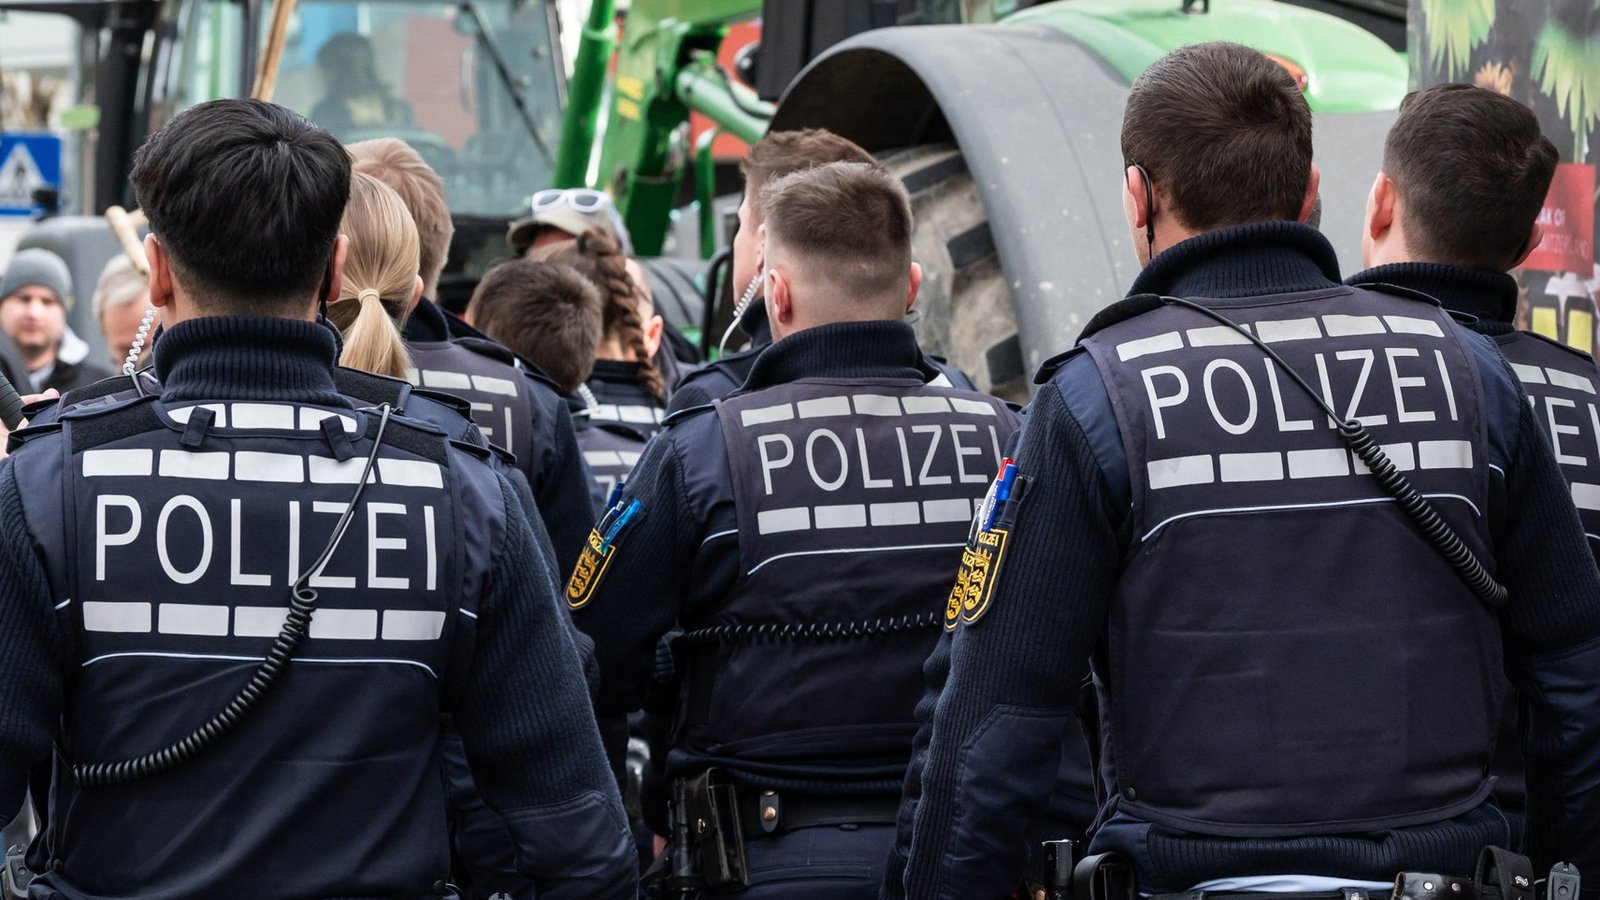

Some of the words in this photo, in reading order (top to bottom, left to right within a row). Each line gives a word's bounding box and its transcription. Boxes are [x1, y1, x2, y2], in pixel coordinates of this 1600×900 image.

[1141, 347, 1458, 439] POLIZEI
[757, 424, 1001, 495] POLIZEI
[96, 494, 436, 590] POLIZEI
